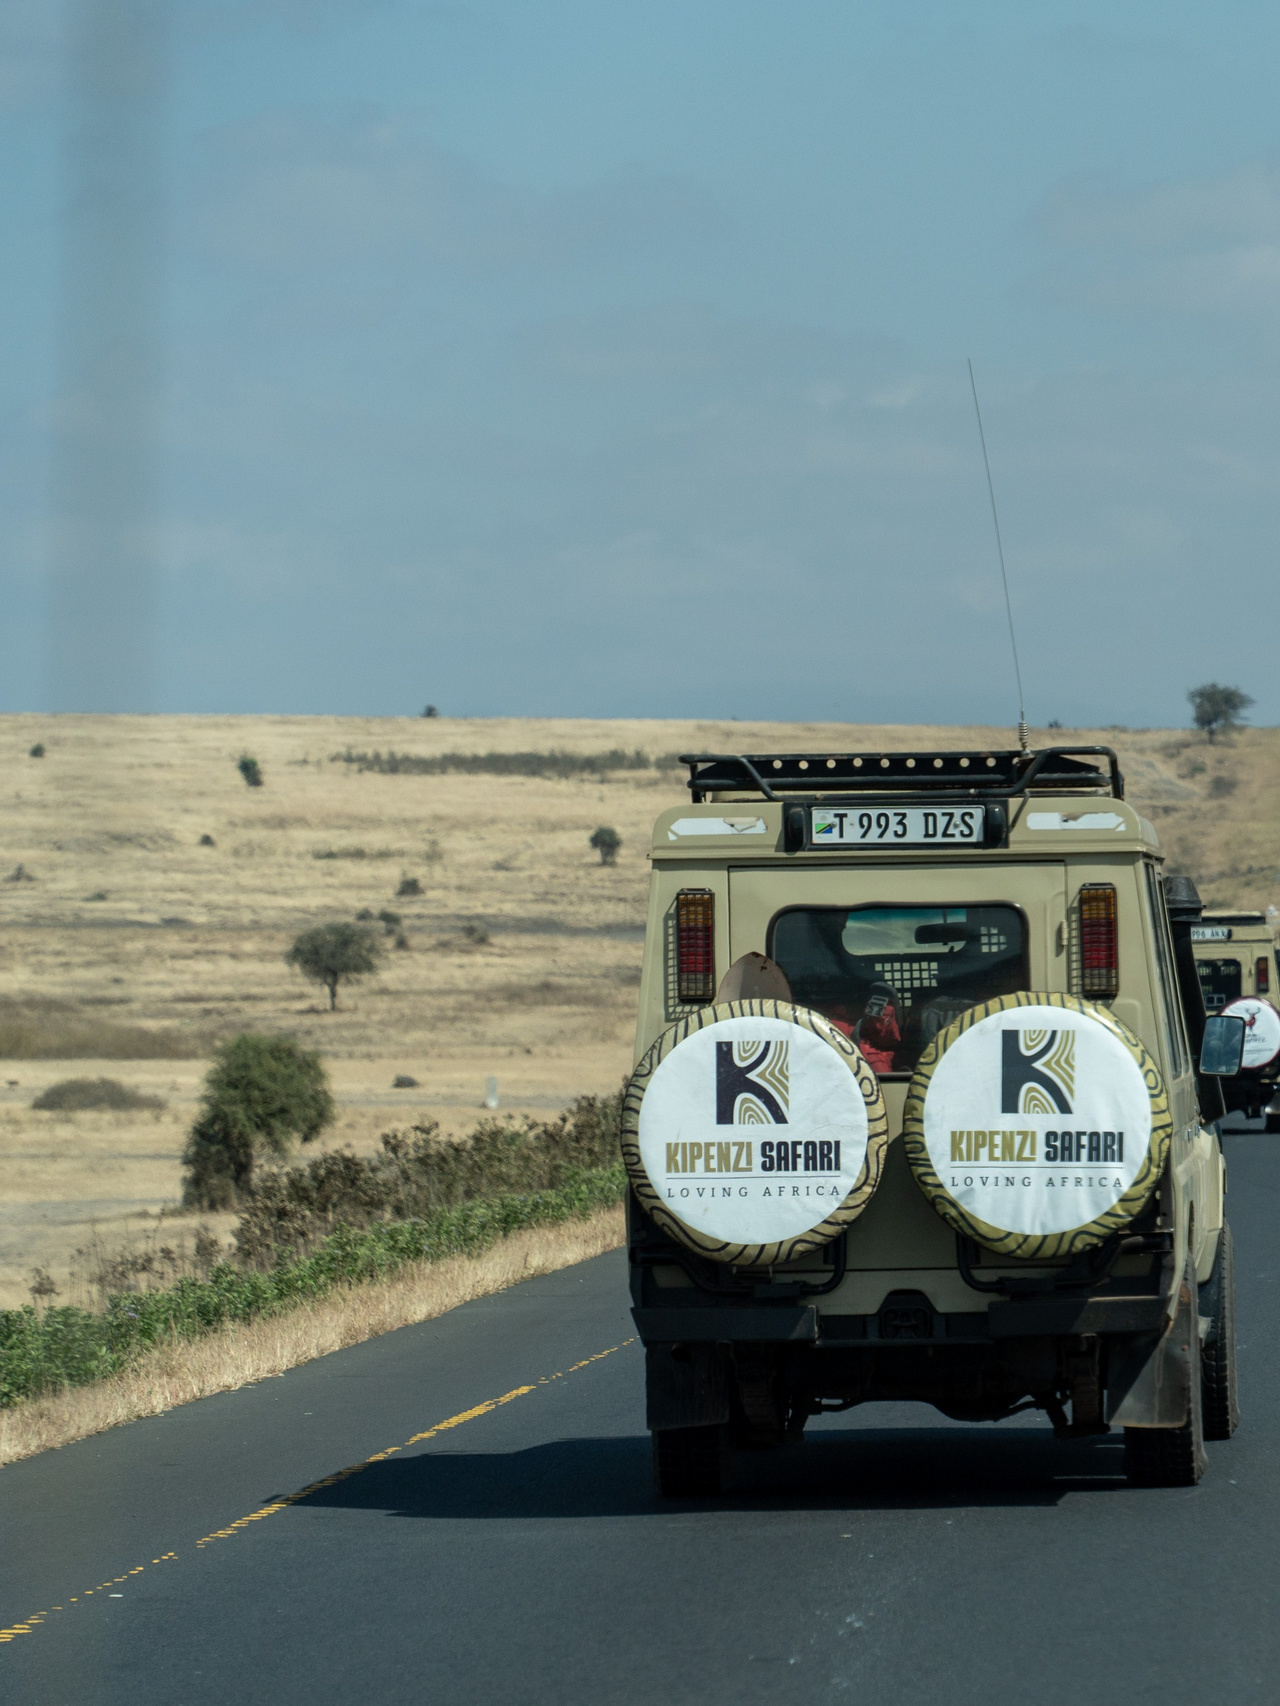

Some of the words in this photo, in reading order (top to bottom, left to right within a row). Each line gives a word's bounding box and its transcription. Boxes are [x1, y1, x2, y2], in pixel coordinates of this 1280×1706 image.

[833, 812, 848, 839] T
[858, 812, 908, 839] 993
[923, 812, 975, 839] DZS
[665, 1141, 753, 1174] KIPENZI
[760, 1140, 841, 1172] SAFARI
[950, 1130, 1037, 1162] KIPENZI
[1045, 1131, 1124, 1163] SAFARI
[667, 1187, 749, 1198] LOVING
[762, 1185, 840, 1198] AFRICA
[951, 1176, 1032, 1188] LOVING
[1045, 1176, 1123, 1188] AFRICA
